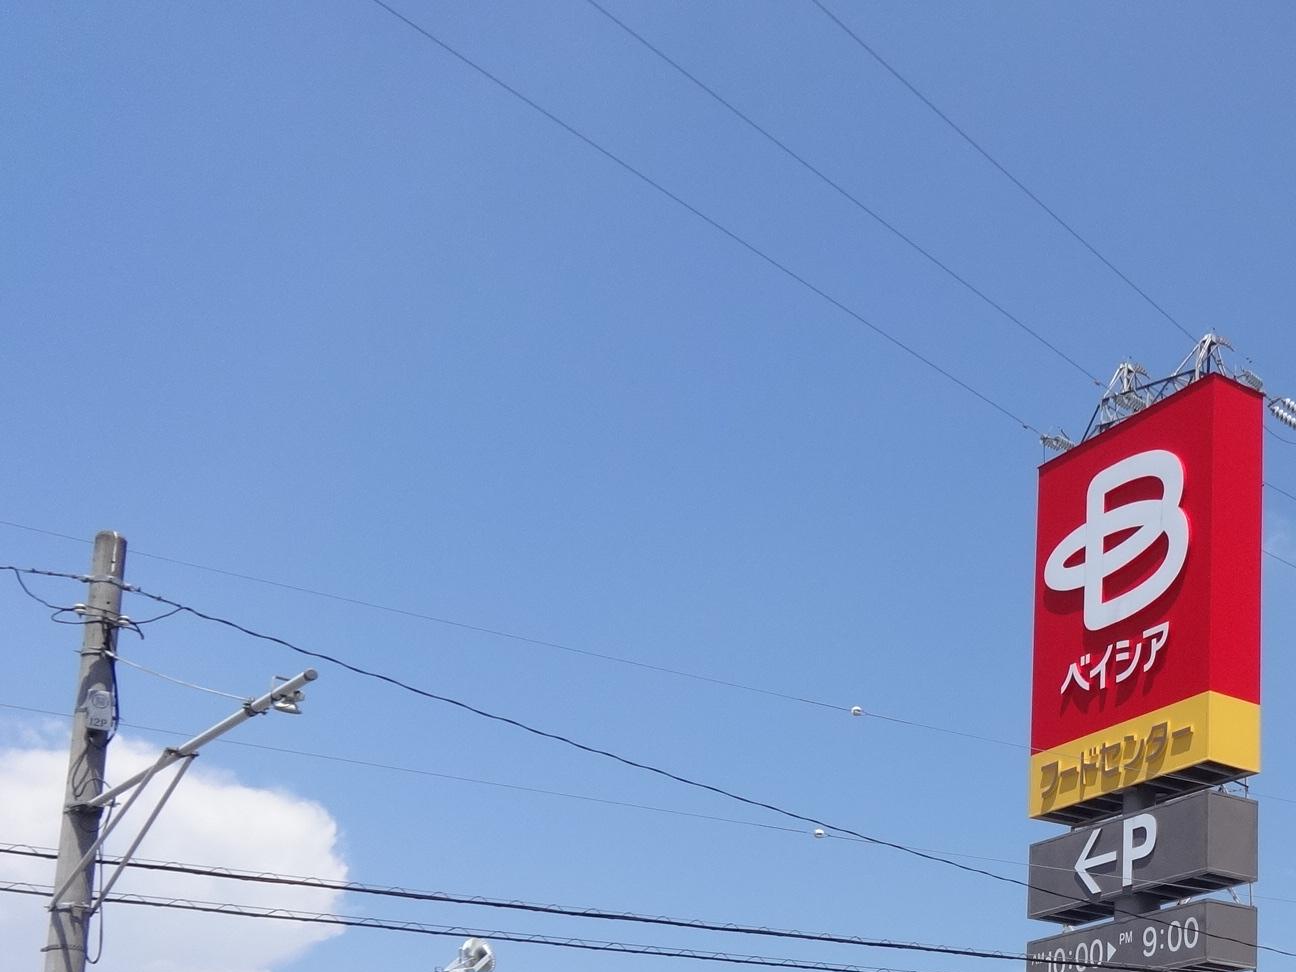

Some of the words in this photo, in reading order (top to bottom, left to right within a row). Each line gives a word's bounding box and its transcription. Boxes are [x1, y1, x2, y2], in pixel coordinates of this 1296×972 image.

[1060, 621, 1169, 695] ベイシア
[1040, 721, 1193, 808] フードセンター
[1121, 813, 1157, 888] P
[1119, 930, 1133, 945] PM
[1143, 917, 1199, 957] 9:00
